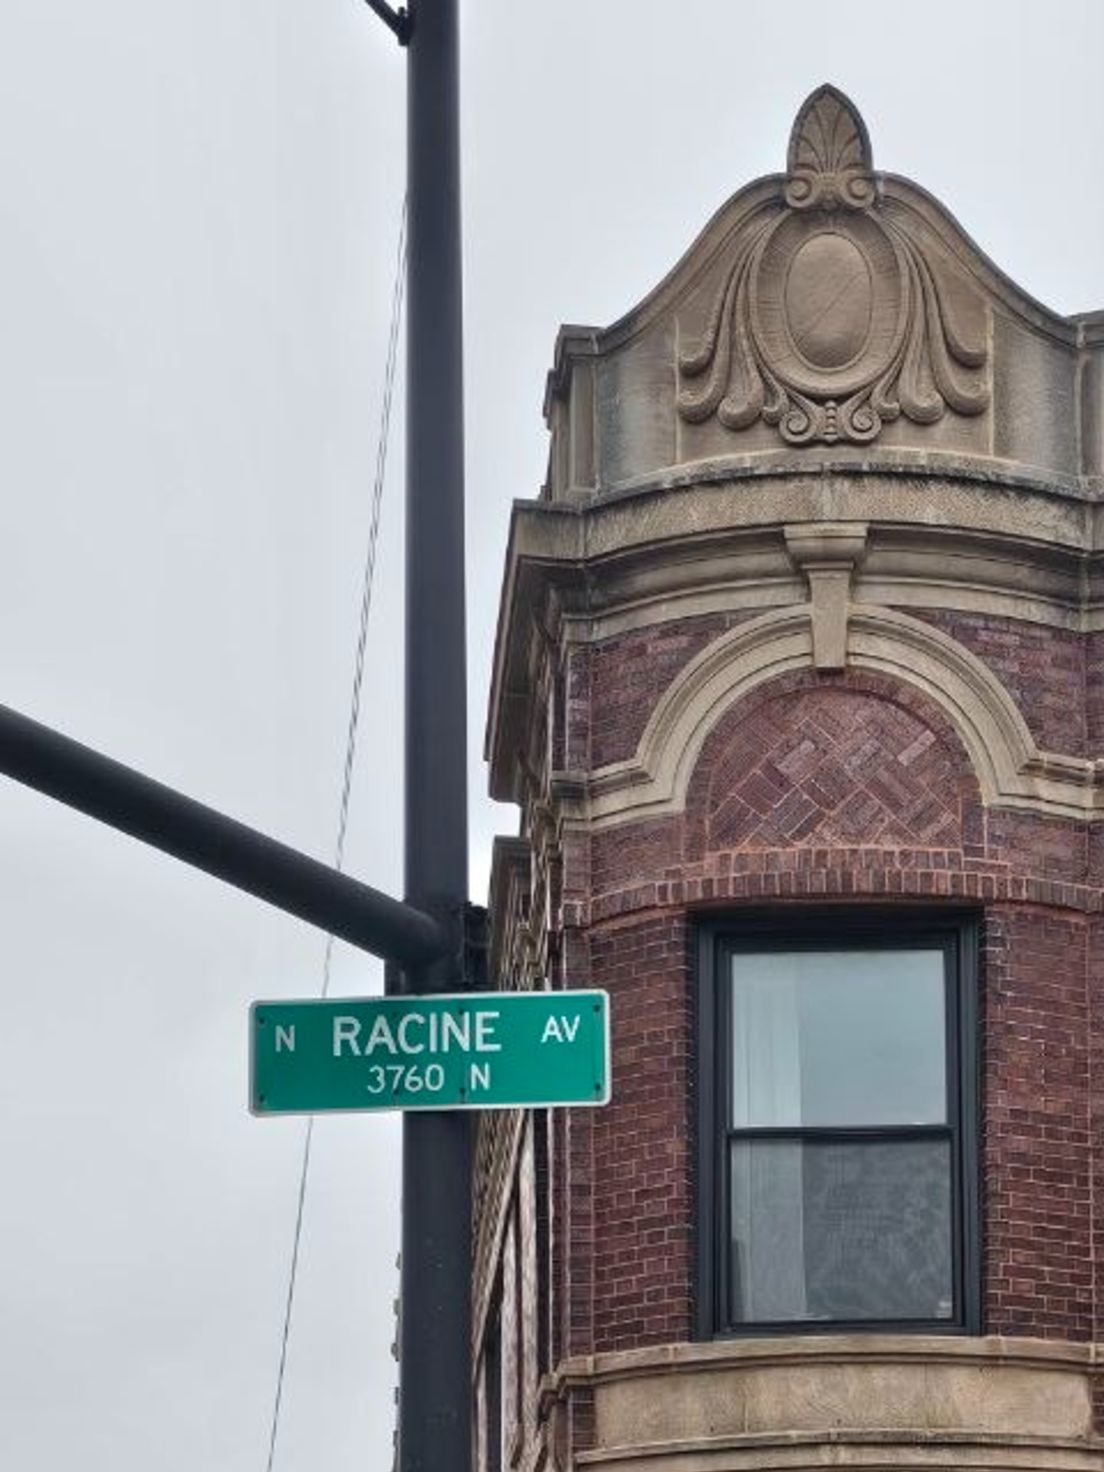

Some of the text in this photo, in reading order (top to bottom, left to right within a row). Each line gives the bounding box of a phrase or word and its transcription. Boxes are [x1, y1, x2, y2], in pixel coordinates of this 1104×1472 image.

[274, 1011, 581, 1057] N RACINE AV
[367, 1063, 491, 1094] 3760 N
